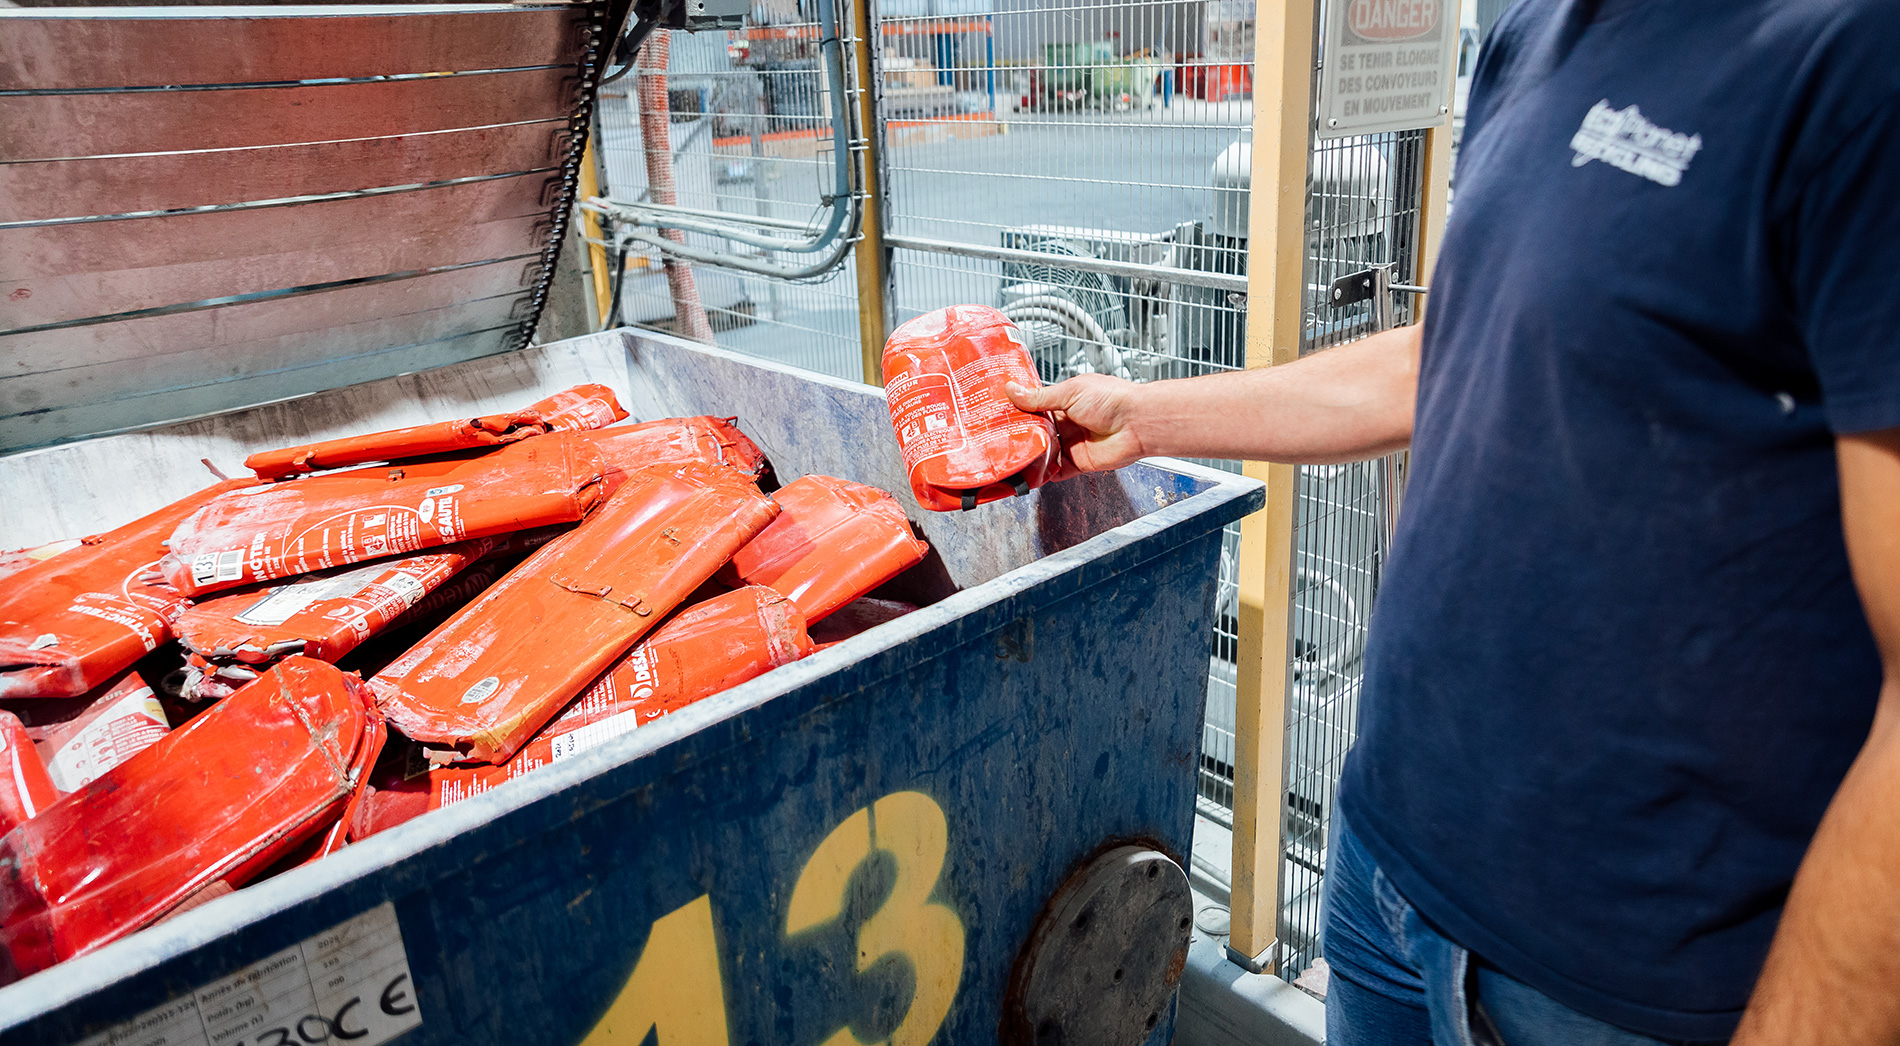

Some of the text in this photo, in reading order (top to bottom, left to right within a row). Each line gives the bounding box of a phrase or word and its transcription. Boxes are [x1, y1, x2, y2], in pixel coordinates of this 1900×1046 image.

[1355, 0, 1434, 29] DANGER
[1339, 53, 1355, 71] SE
[1358, 51, 1393, 70] TENIR
[1338, 71, 1438, 94] DES CONVOYEURS
[1343, 93, 1432, 117] EN MOUVEMENT
[195, 554, 215, 584] 135
[67, 604, 157, 652] EXTINCTEUR
